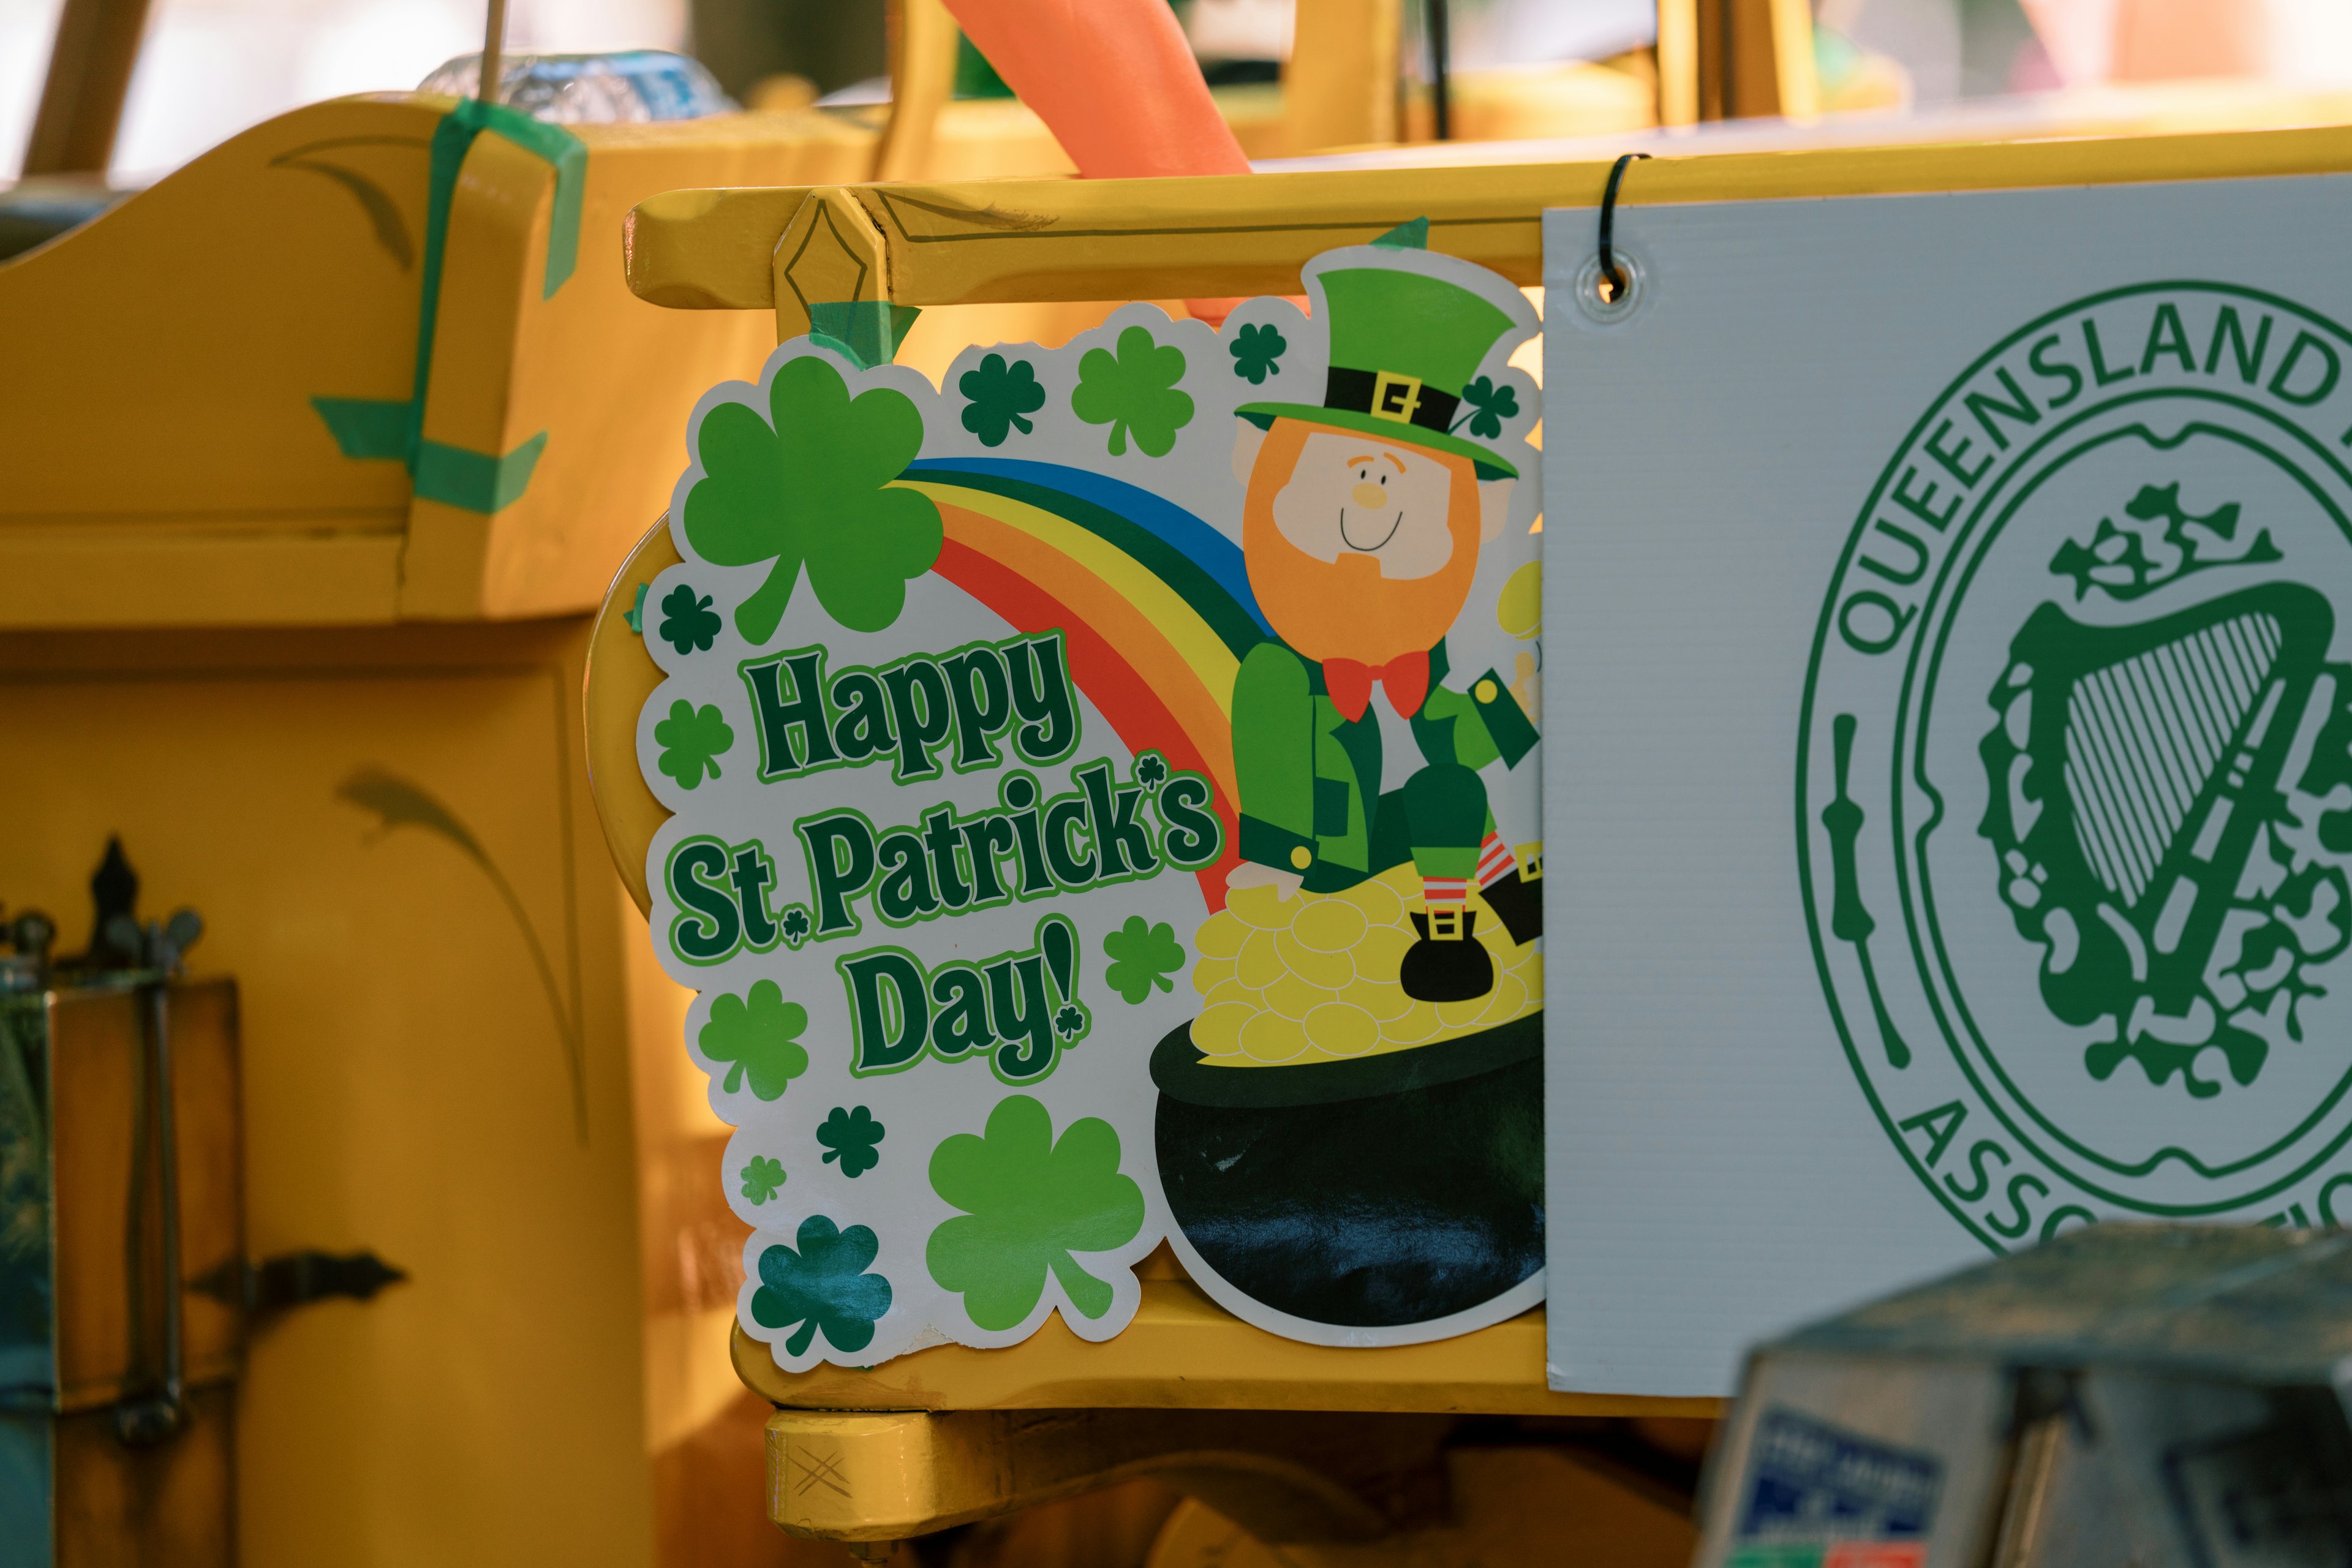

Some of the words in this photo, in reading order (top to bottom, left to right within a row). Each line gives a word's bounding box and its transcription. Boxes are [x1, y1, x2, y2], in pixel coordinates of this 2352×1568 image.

[1838, 303, 2342, 655] QUEENSLAND
[742, 631, 1077, 780] Happy
[797, 755, 1221, 937] Patrick's
[840, 919, 1088, 1080] Day!
